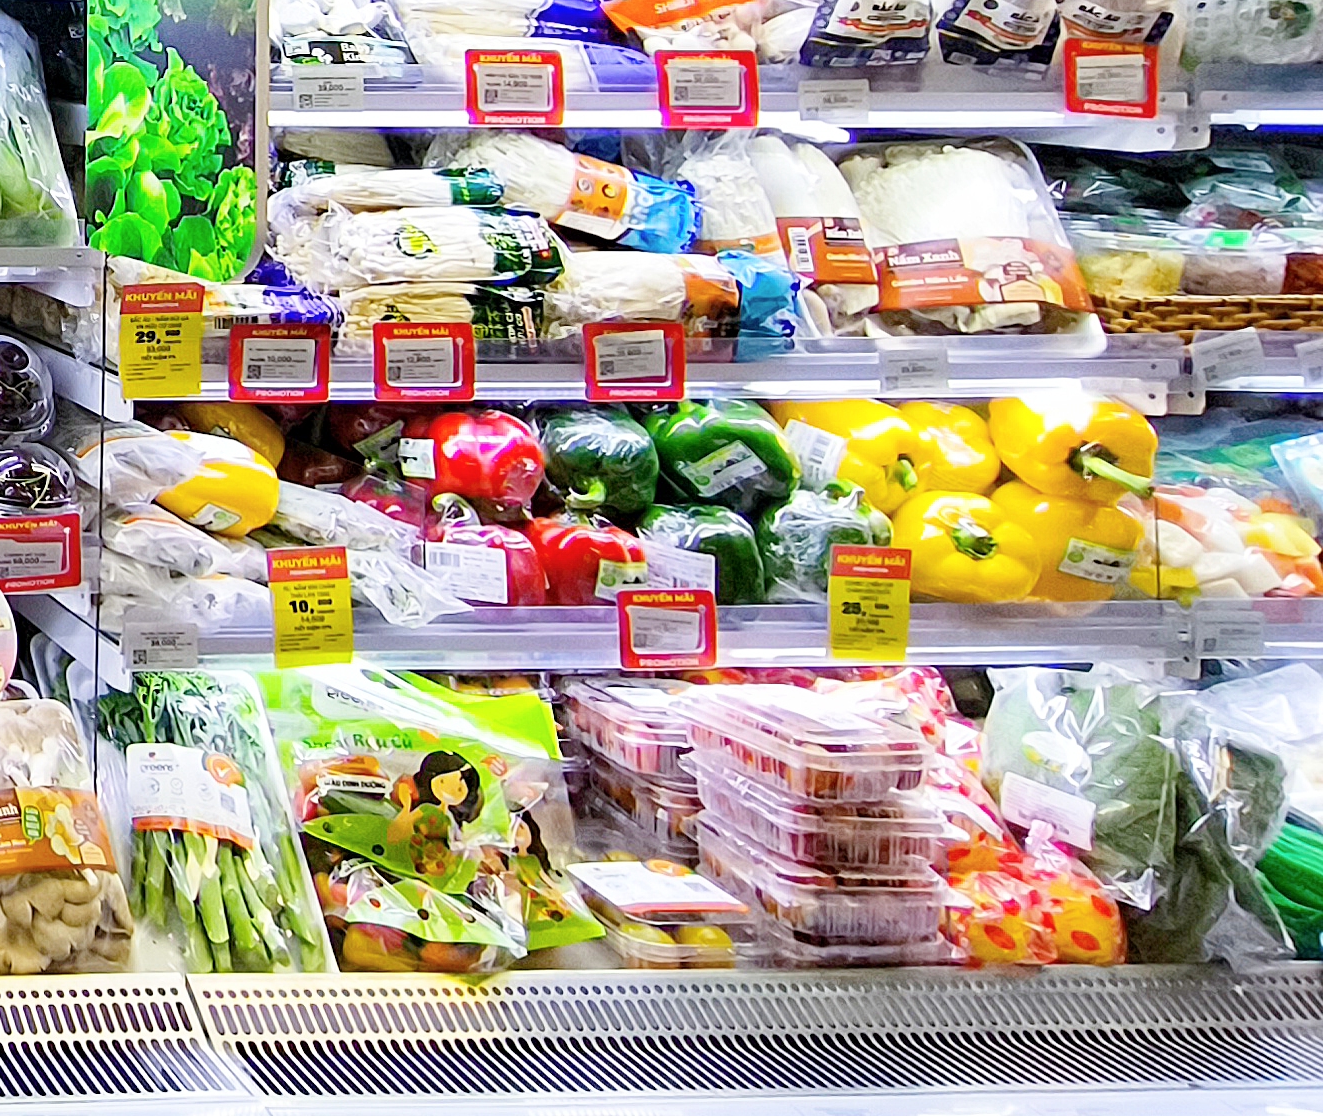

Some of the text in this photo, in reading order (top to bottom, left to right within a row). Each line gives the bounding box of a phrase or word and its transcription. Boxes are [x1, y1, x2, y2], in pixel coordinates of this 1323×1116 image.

[888, 253, 921, 268] Nấm
[124, 291, 173, 303] KHUYẾN
[134, 329, 162, 345] 29,
[272, 557, 318, 569] KHUYẾN
[5, 579, 56, 588] PROMOTION
[288, 599, 315, 615] 10,
